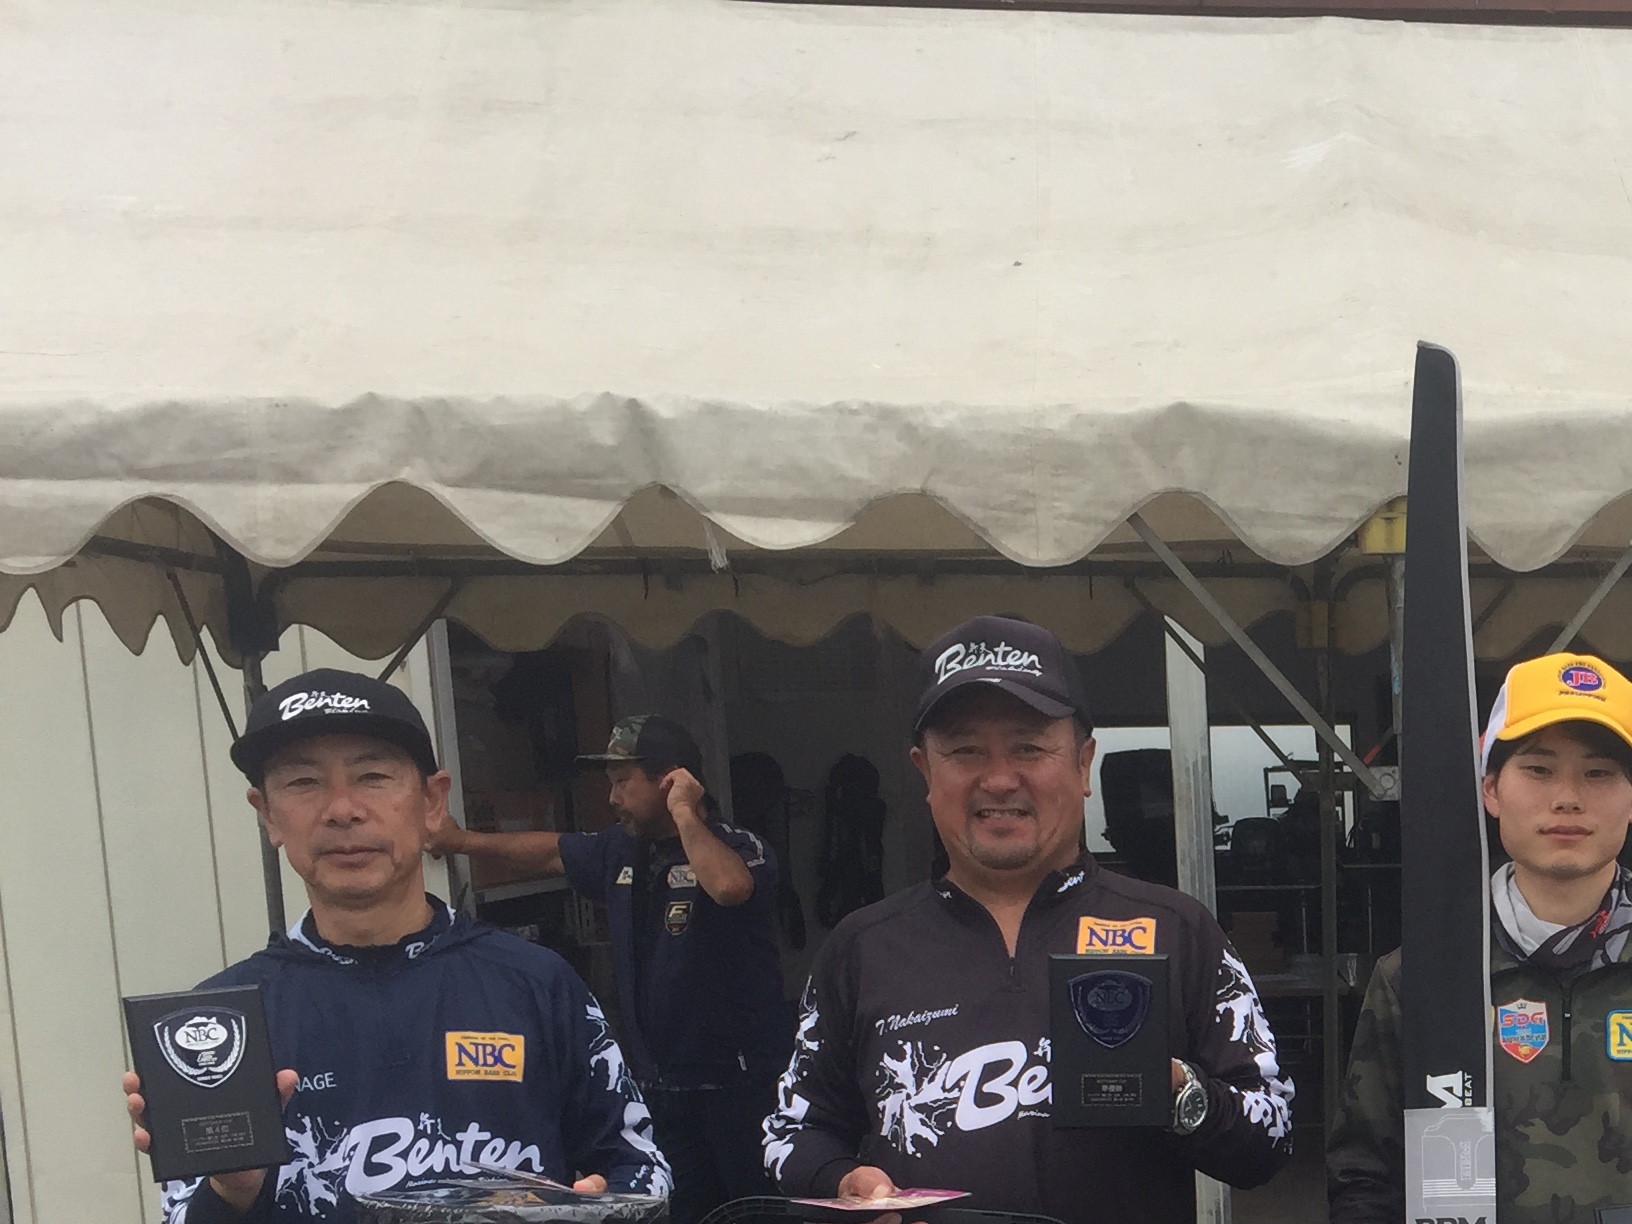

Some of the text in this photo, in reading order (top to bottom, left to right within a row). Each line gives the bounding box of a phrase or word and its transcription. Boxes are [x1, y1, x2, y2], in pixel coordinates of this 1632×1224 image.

[934, 641, 1042, 685] Benten
[1566, 669, 1599, 687] JB
[278, 692, 371, 721] Benten
[1085, 925, 1148, 950] NBC
[1502, 1011, 1545, 1027] SDG
[184, 1027, 220, 1044] NBC
[455, 1042, 517, 1069] NBC
[945, 1040, 1052, 1132] Be
[344, 1116, 545, 1198] Benten
